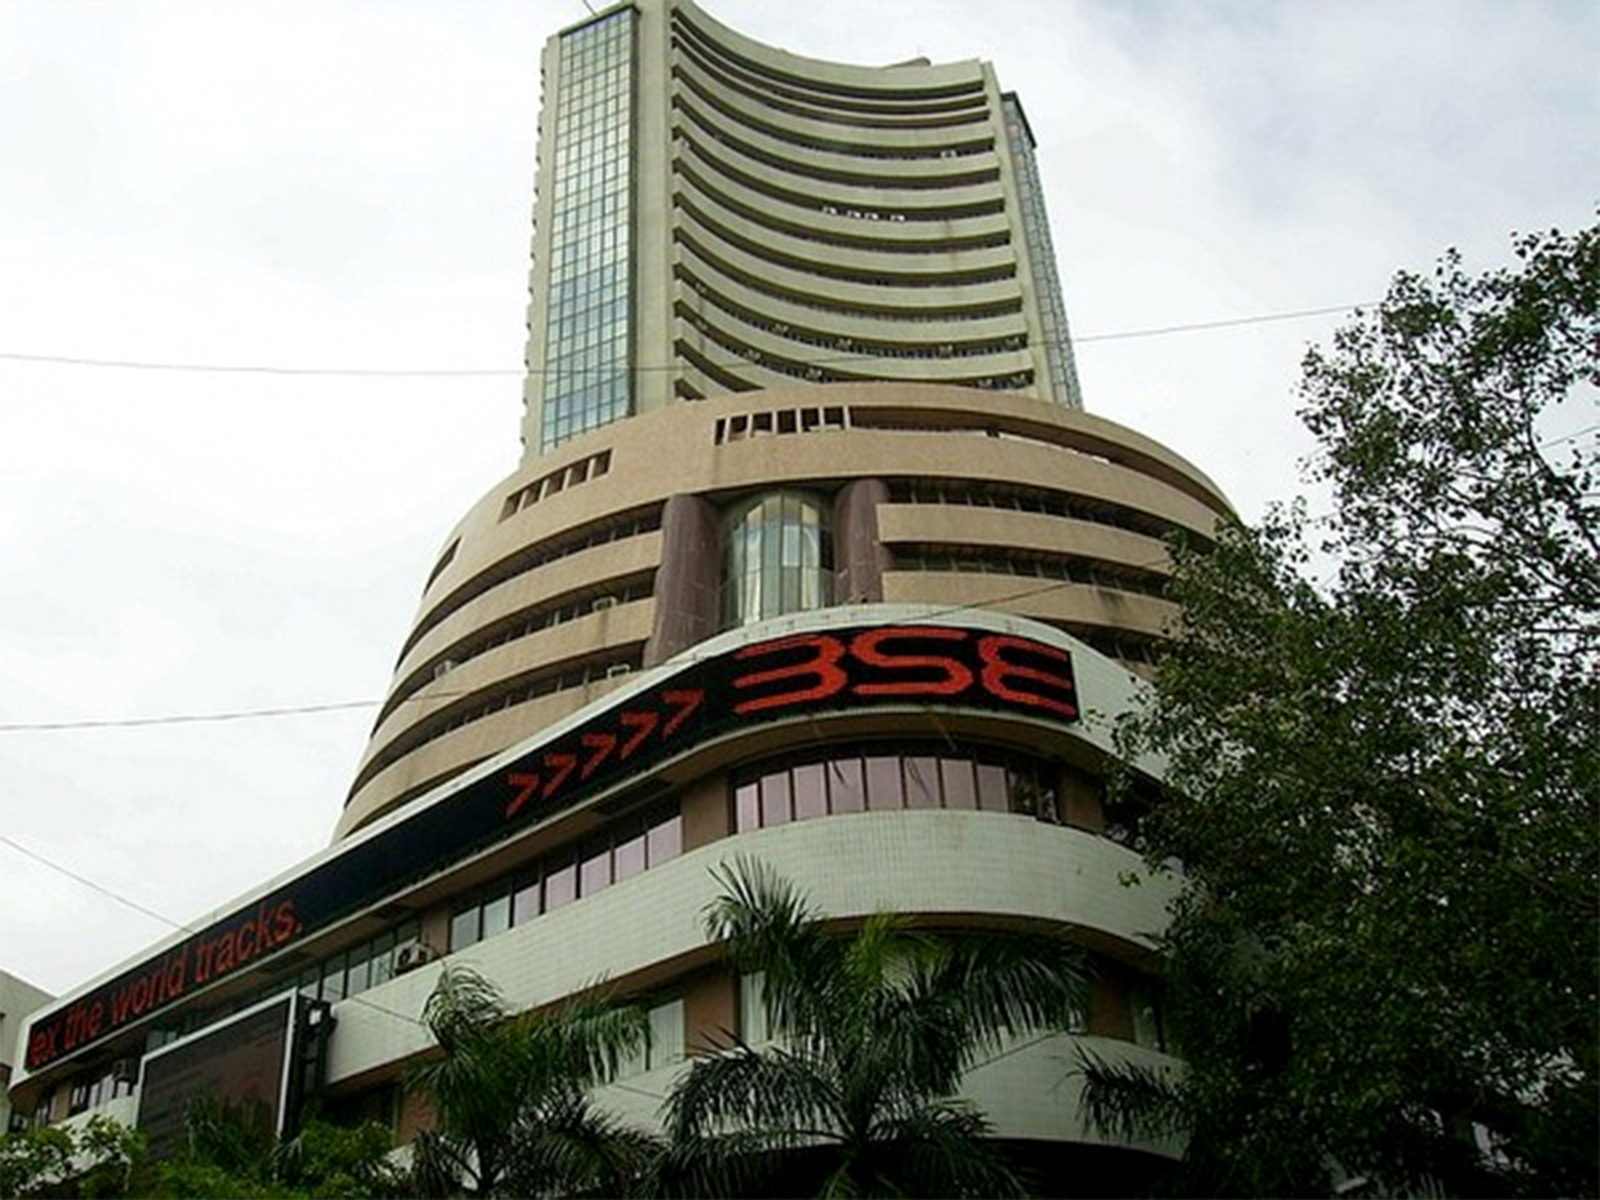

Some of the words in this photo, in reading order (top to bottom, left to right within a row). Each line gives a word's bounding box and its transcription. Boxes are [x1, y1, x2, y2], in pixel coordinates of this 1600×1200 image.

[732, 626, 1078, 717] BSE
[29, 1022, 60, 1067] ex
[63, 998, 104, 1050] the
[111, 945, 188, 1025] world
